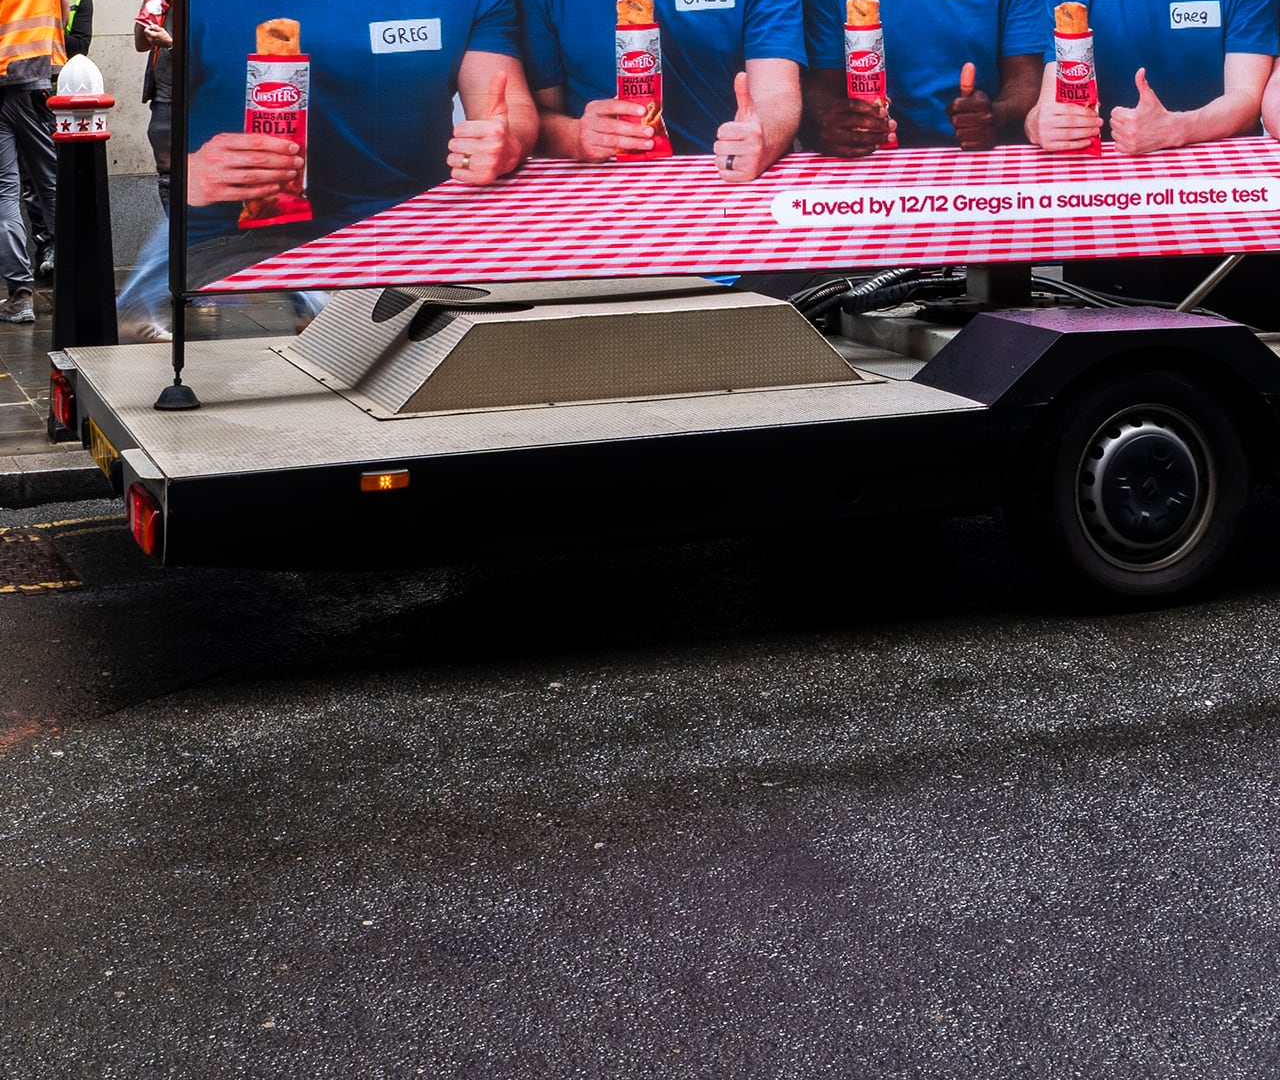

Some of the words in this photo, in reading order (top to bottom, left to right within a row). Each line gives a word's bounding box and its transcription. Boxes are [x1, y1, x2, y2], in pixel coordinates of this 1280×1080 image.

[382, 25, 428, 45] GREG
[623, 83, 655, 96] ROLL
[851, 81, 880, 93] ROLL
[1060, 88, 1090, 100] ROLL
[252, 120, 297, 135] ROLL
[869, 196, 896, 217] by
[899, 194, 949, 213] 12/12
[953, 194, 1013, 214] Gregs
[1017, 192, 1034, 209] in
[1038, 195, 1052, 209] a
[1056, 192, 1142, 210] sausage
[1146, 188, 1174, 206] roll
[1178, 187, 1228, 205] taste
[1231, 186, 1269, 203] test
